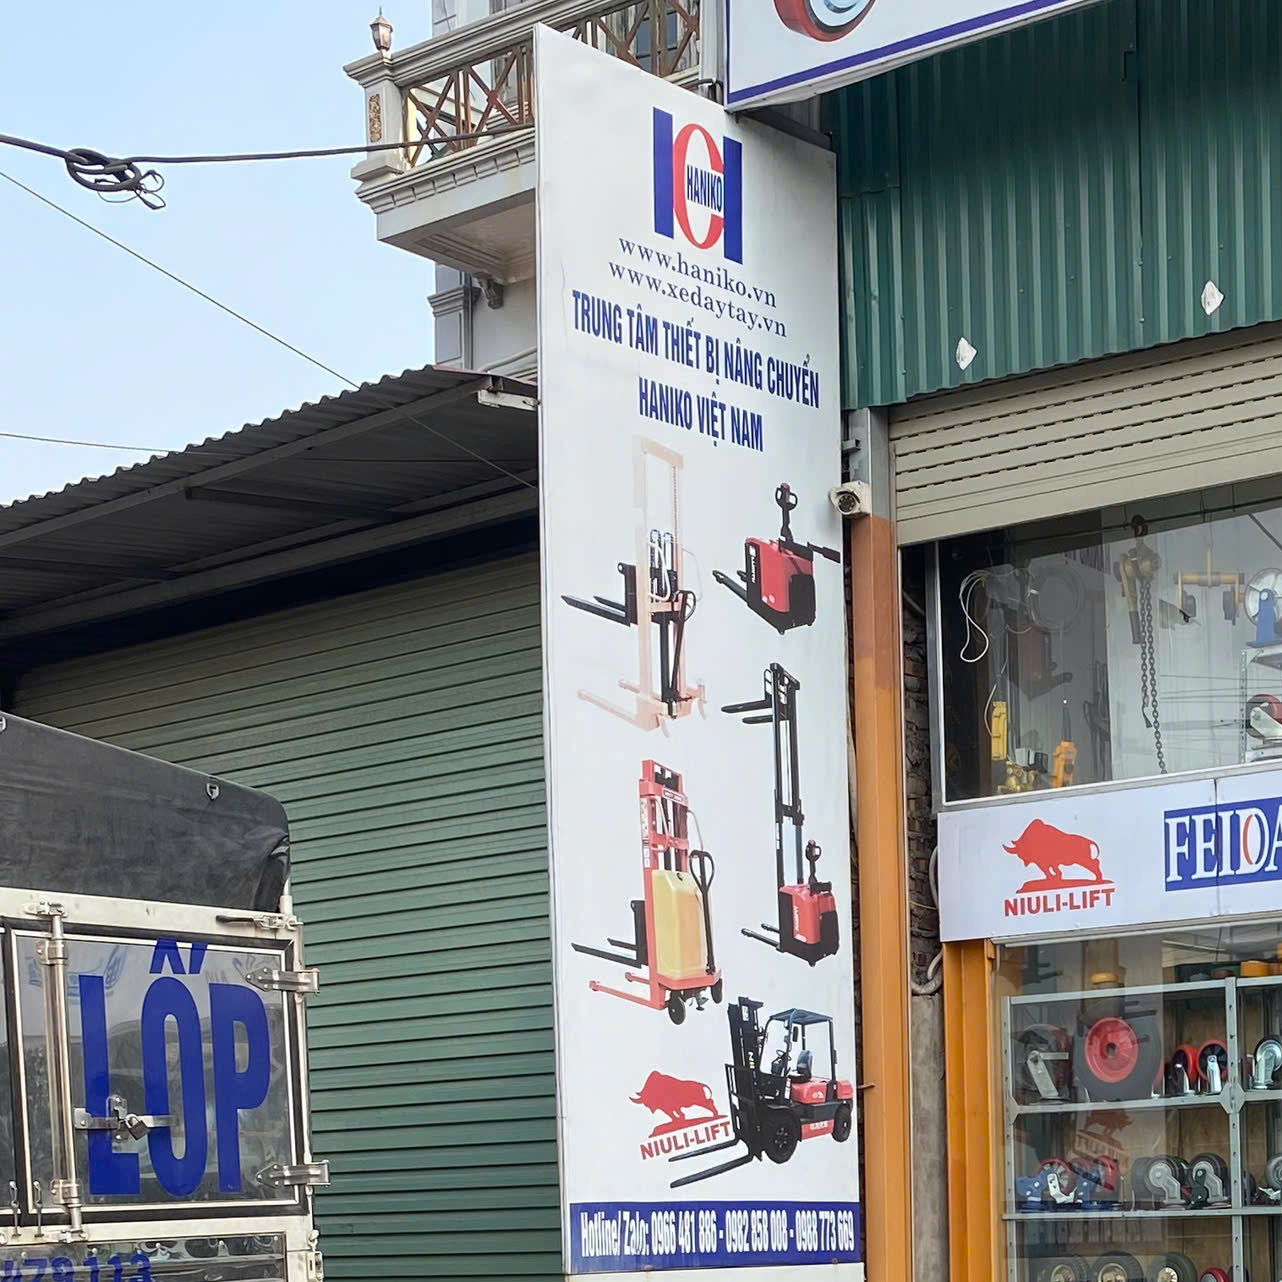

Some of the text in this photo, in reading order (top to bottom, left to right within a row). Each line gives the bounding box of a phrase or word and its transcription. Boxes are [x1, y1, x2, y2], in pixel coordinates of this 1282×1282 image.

[686, 164, 723, 213] HANIKO
[608, 261, 787, 338] www.xedaytay.vn
[618, 237, 777, 309] www.haniko.vn
[572, 289, 820, 409] TRUNG TÂM THIẾT BỊ NÂNG CHUYỂN
[638, 376, 763, 452] HANIKO VIỆT NAM
[1003, 888, 1115, 917] NIULI-LIFT
[79, 936, 271, 1197] LỐP
[640, 1120, 730, 1161] NIULI-LIFT
[651, 1210, 676, 1255] 0966
[678, 1210, 696, 1253] 481
[699, 1210, 718, 1254] 886
[725, 1210, 750, 1253] 0982
[751, 1209, 769, 1253] 858
[770, 1209, 788, 1253] 008
[795, 1210, 818, 1252] 0988
[819, 1210, 837, 1252] 773
[837, 1210, 855, 1252] 669
